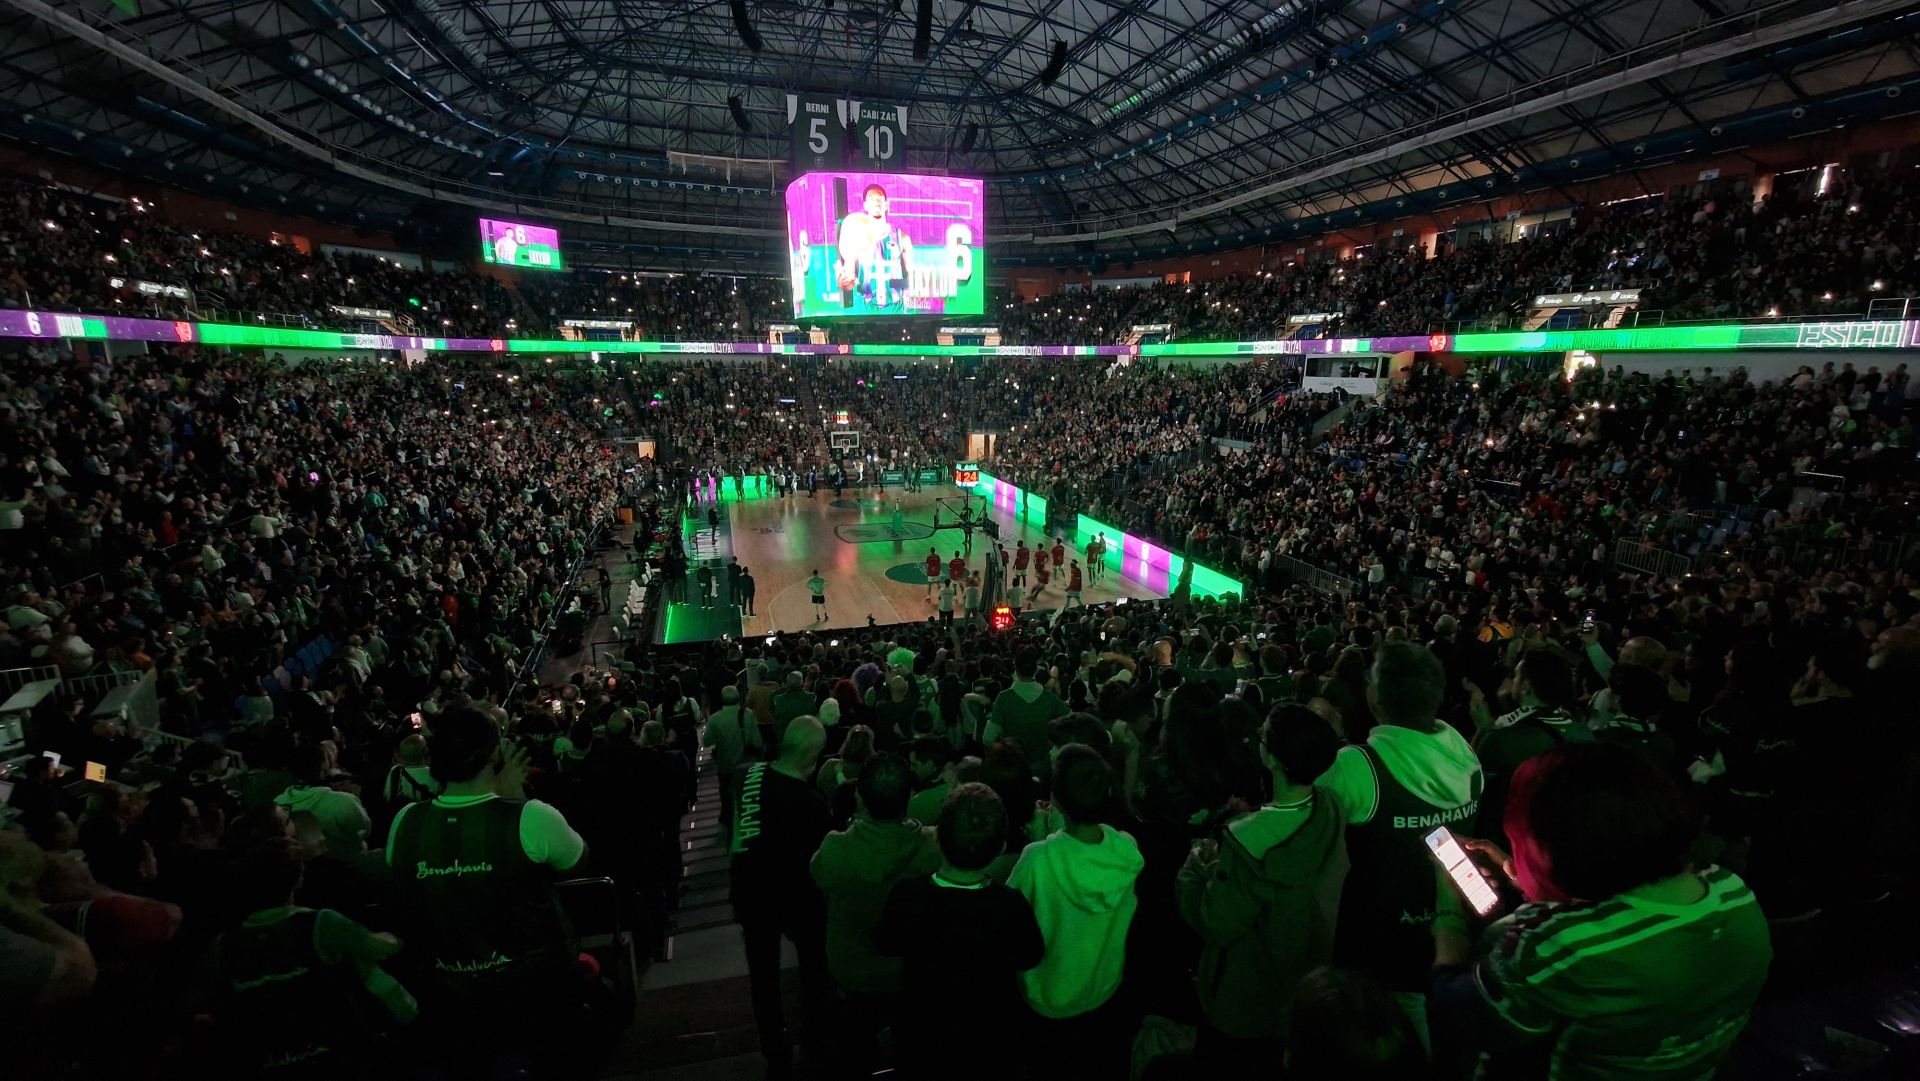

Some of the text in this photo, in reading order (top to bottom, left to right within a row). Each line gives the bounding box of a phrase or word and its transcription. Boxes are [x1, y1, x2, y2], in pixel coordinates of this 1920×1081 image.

[806, 102, 829, 113] BERNI
[808, 118, 829, 154] 5
[864, 124, 893, 160] 10
[516, 226, 526, 245] 6
[947, 224, 972, 282] 6
[27, 311, 42, 335] 6
[964, 471, 977, 482] 24
[739, 762, 768, 840] UNICAJA
